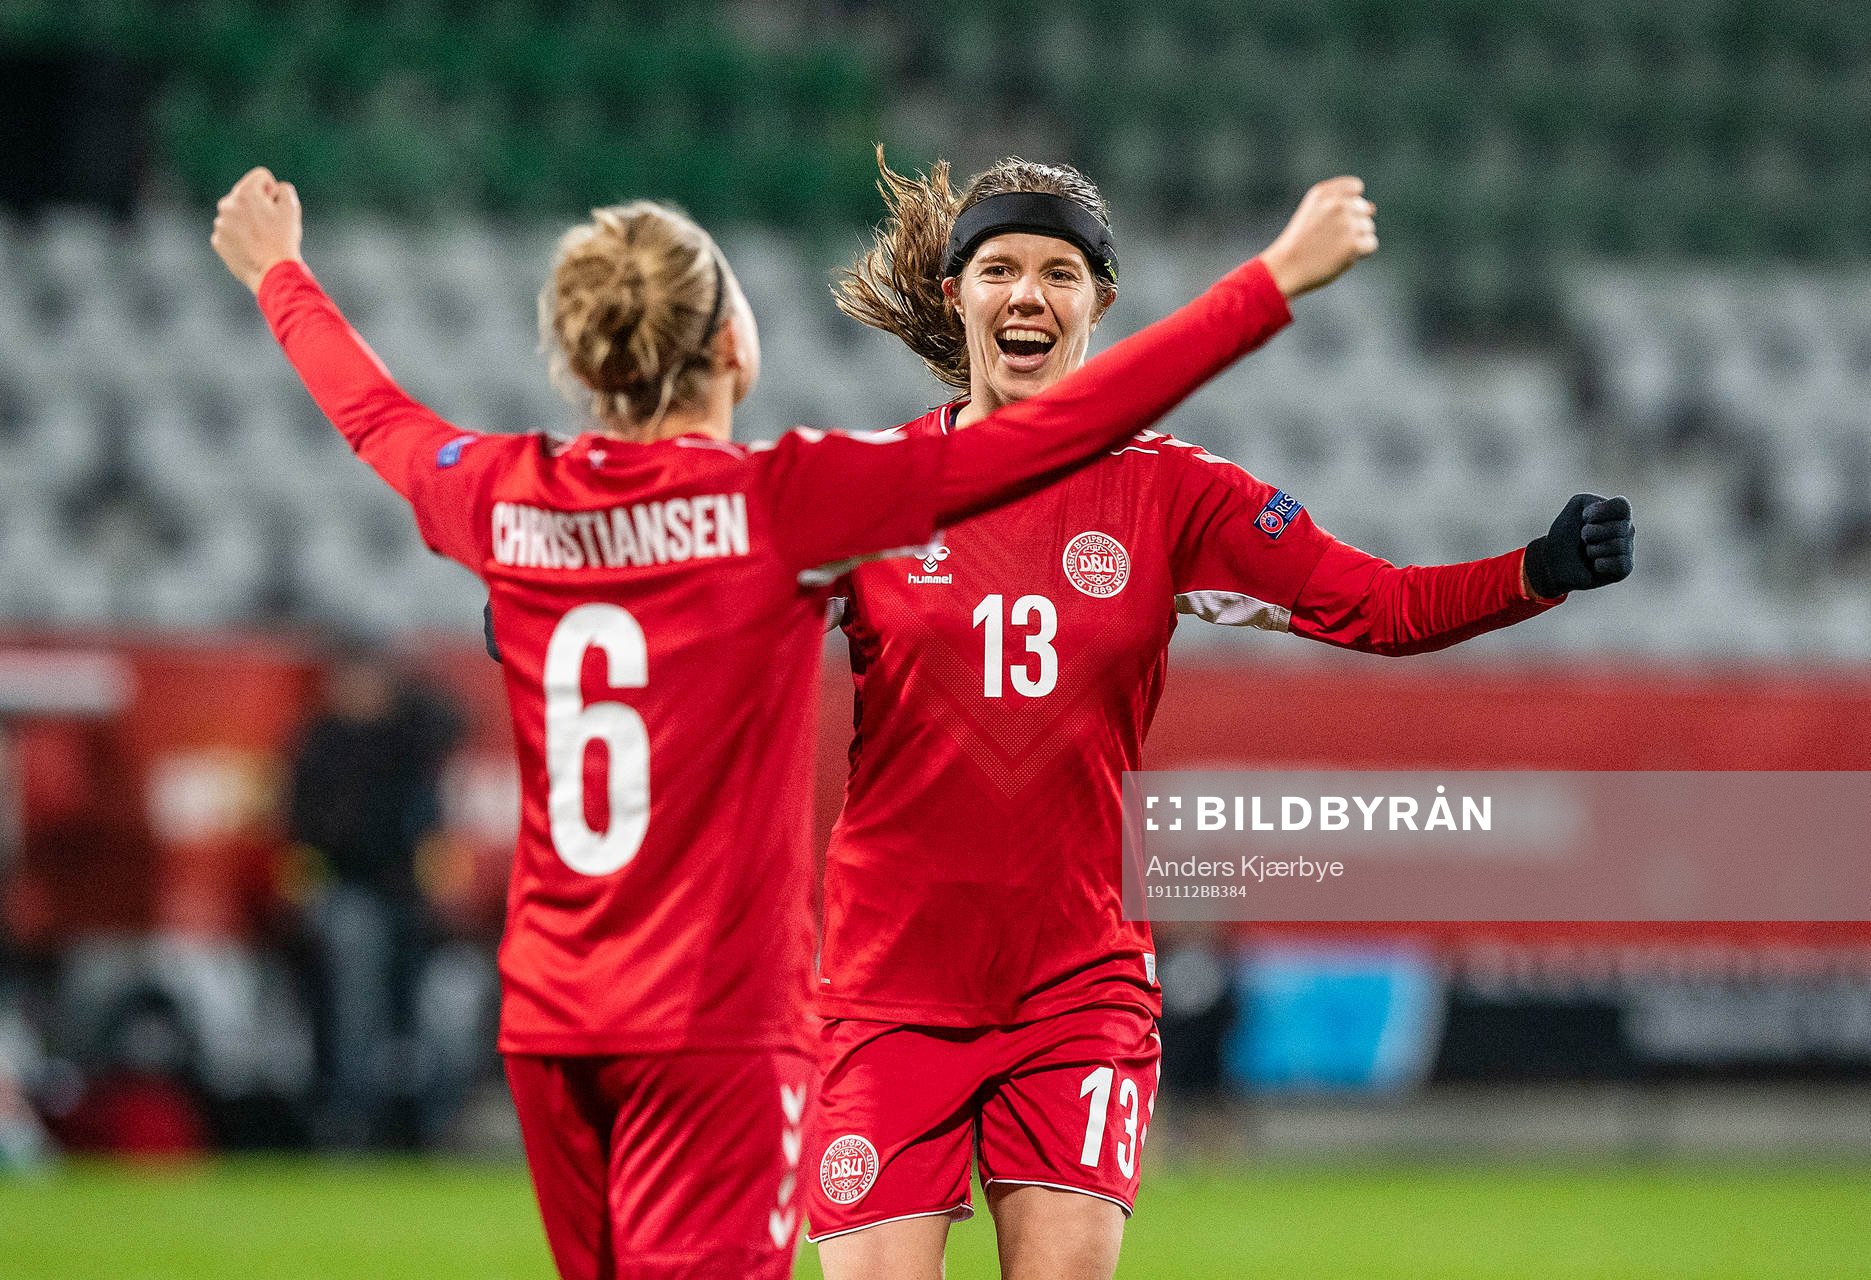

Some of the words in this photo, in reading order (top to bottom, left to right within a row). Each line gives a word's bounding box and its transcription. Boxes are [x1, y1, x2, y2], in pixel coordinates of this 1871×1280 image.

[491, 493, 750, 569] CHRISTIANSEN
[907, 572, 953, 584] hummel
[1078, 554, 1116, 573] DBU
[1113, 553, 1127, 588] UNION
[1087, 584, 1113, 595] 1889
[972, 593, 1059, 698] 13
[543, 602, 651, 877] 6
[1079, 1066, 1139, 1180] 13
[831, 1157, 864, 1180] DBU
[836, 1189, 859, 1201] 1889
